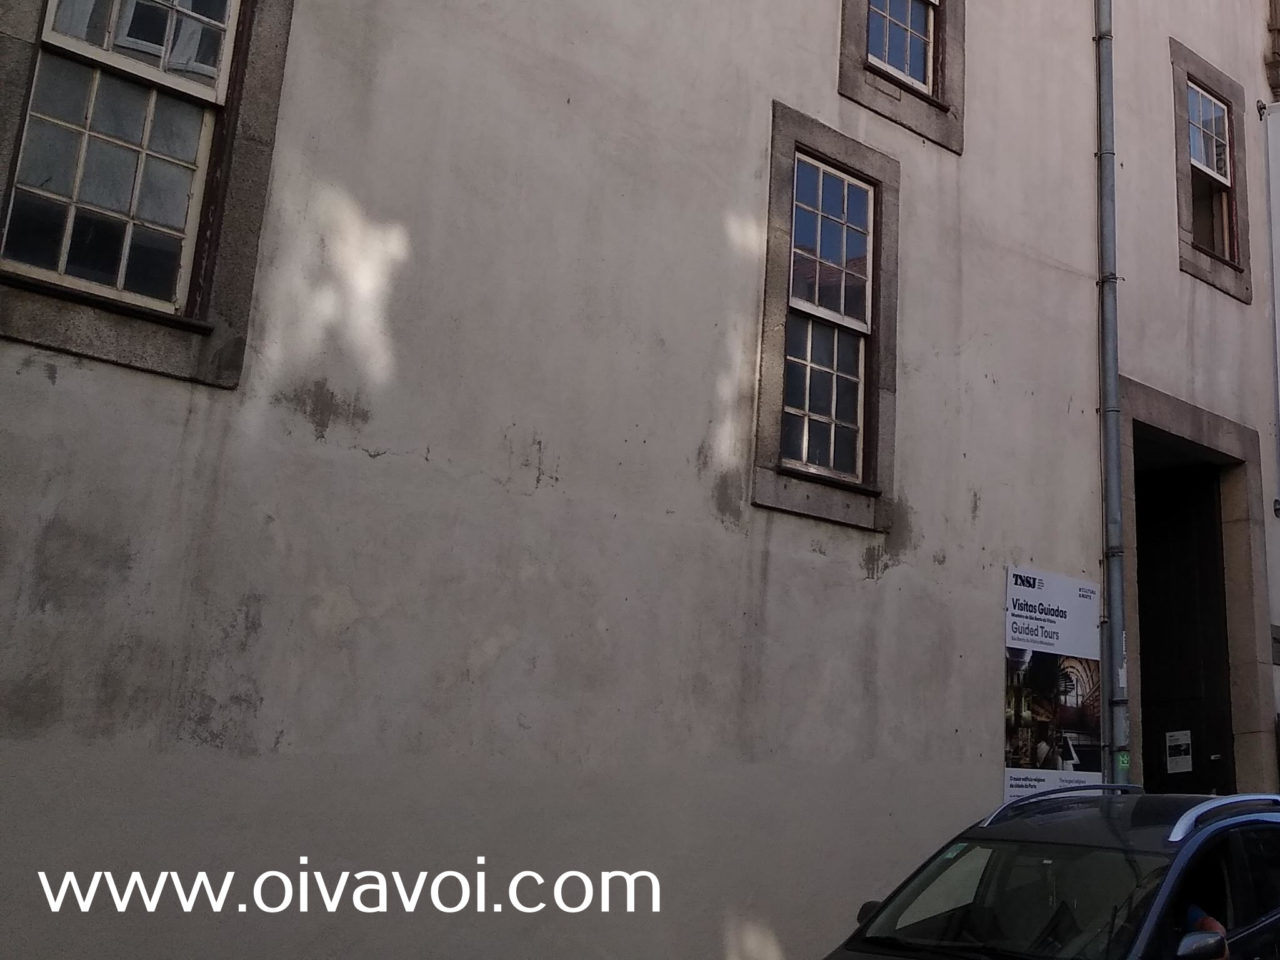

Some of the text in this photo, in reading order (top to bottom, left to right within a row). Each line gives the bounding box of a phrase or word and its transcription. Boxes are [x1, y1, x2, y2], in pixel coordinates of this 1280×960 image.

[1012, 573, 1037, 588] TNSJ
[1012, 598, 1037, 614] Visitas
[1038, 602, 1067, 619] Guiadas
[1012, 621, 1059, 640] Guided Tours
